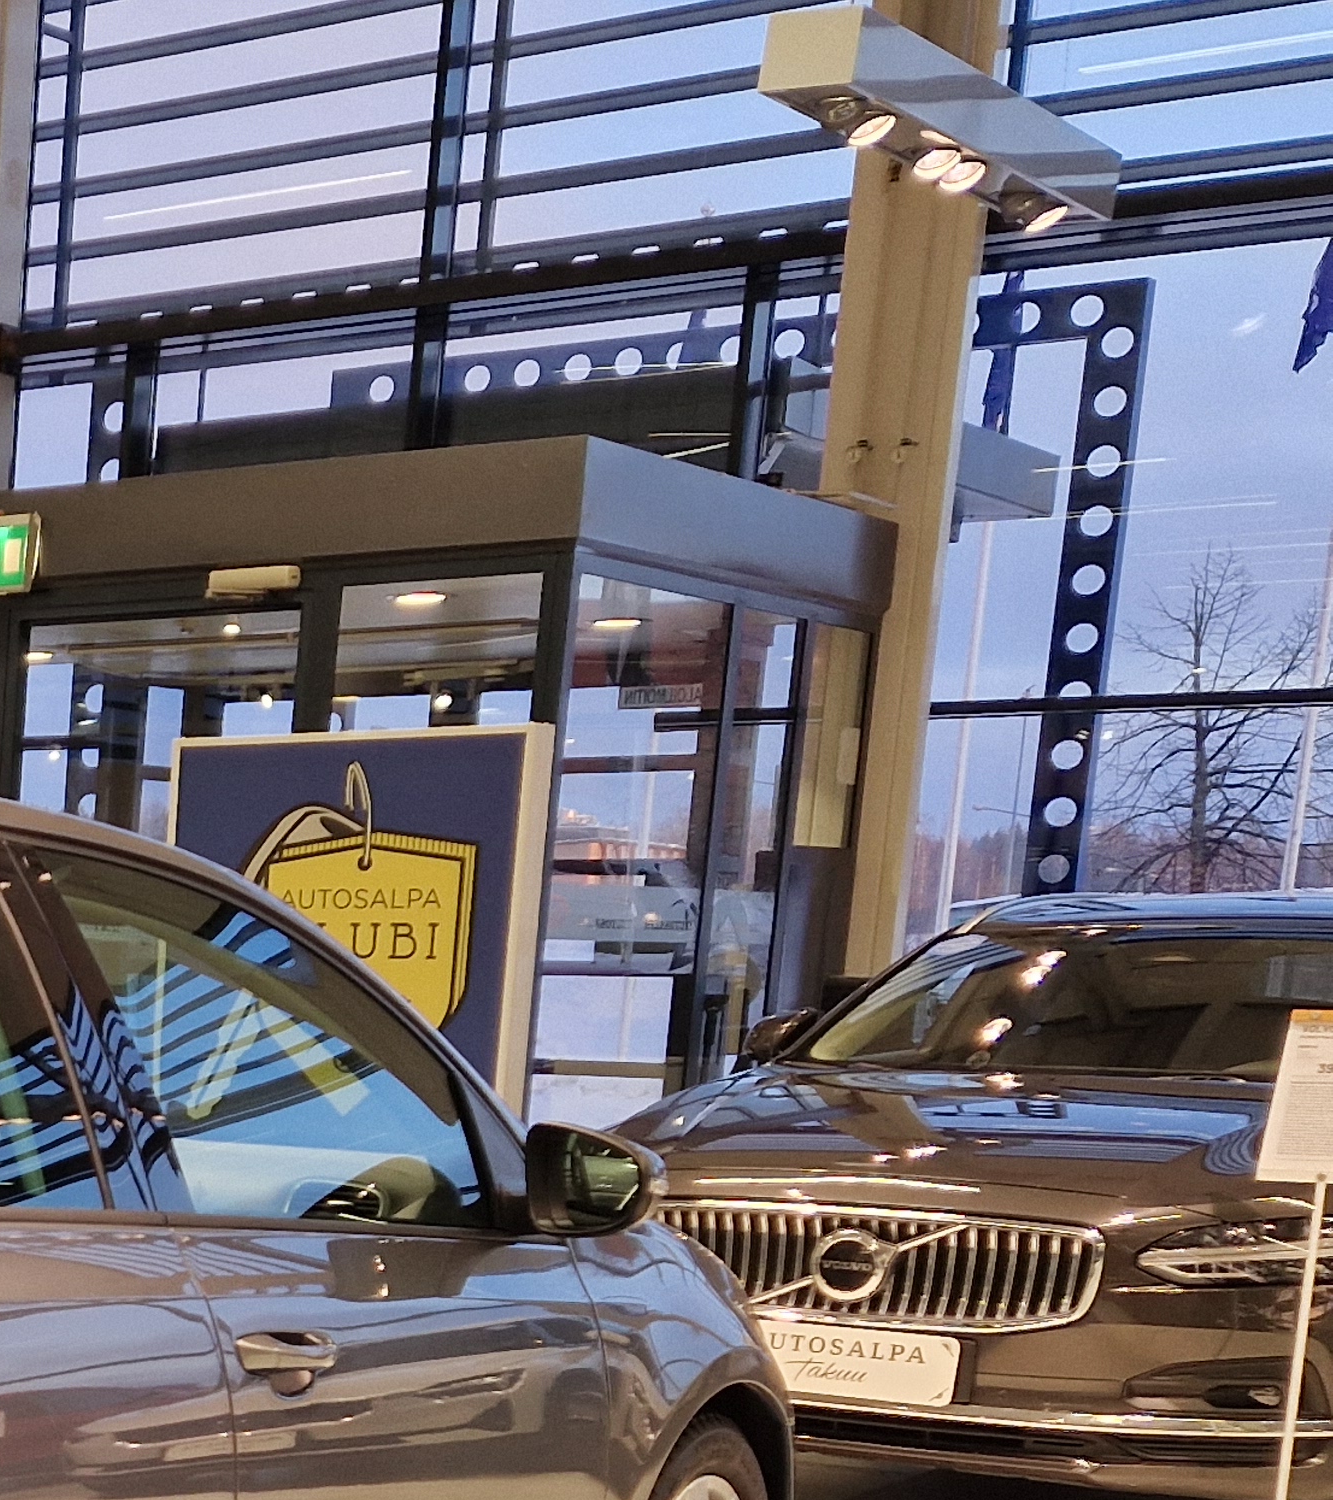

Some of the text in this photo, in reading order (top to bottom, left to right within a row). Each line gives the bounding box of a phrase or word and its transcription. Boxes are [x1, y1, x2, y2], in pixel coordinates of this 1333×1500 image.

[282, 887, 442, 910] AUTOSALPA
[317, 921, 441, 960] UBI
[785, 1357, 870, 1383] Takuu
